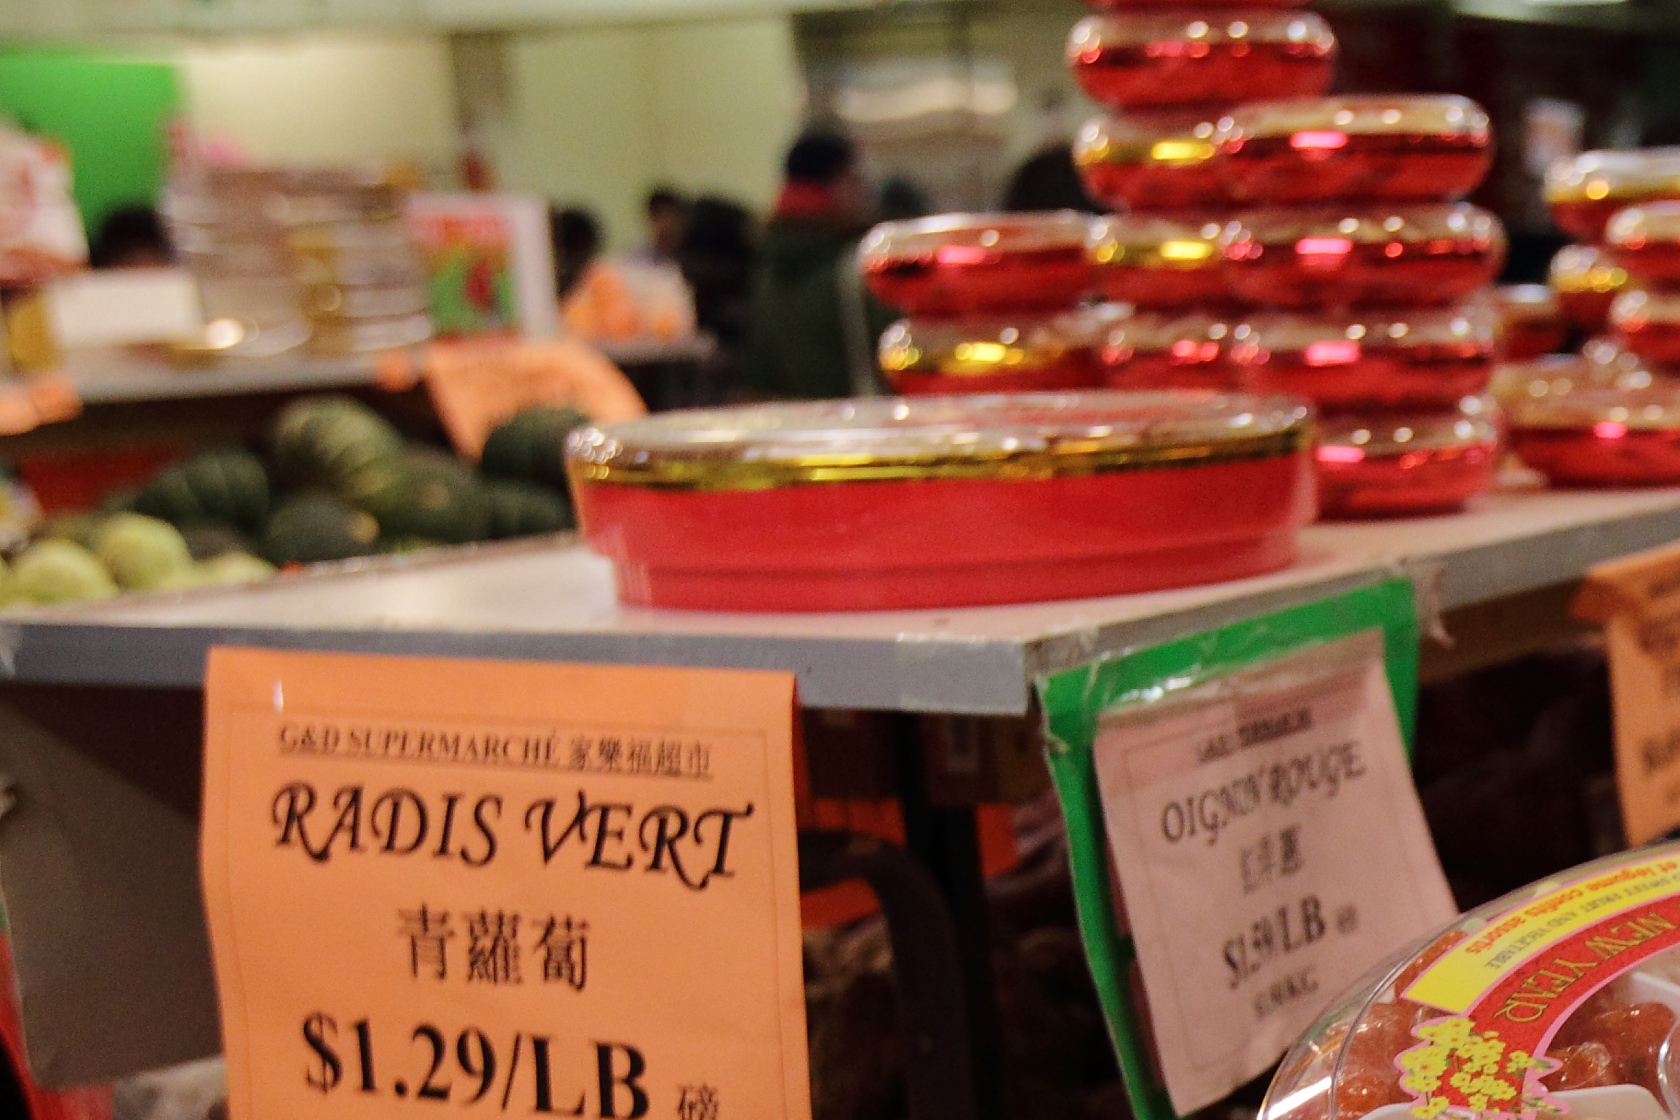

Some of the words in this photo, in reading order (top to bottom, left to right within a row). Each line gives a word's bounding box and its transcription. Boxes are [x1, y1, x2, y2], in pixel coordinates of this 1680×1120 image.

[278, 722, 341, 754] G&D
[348, 726, 561, 766] SUPERMARCHÉ
[569, 733, 712, 775] 家樂福超市
[272, 780, 504, 868] RADIS
[524, 789, 755, 891] VERT
[397, 903, 591, 993] 青蘿蔔
[1584, 912, 1679, 961] NEW
[1492, 957, 1599, 1023] YEAR
